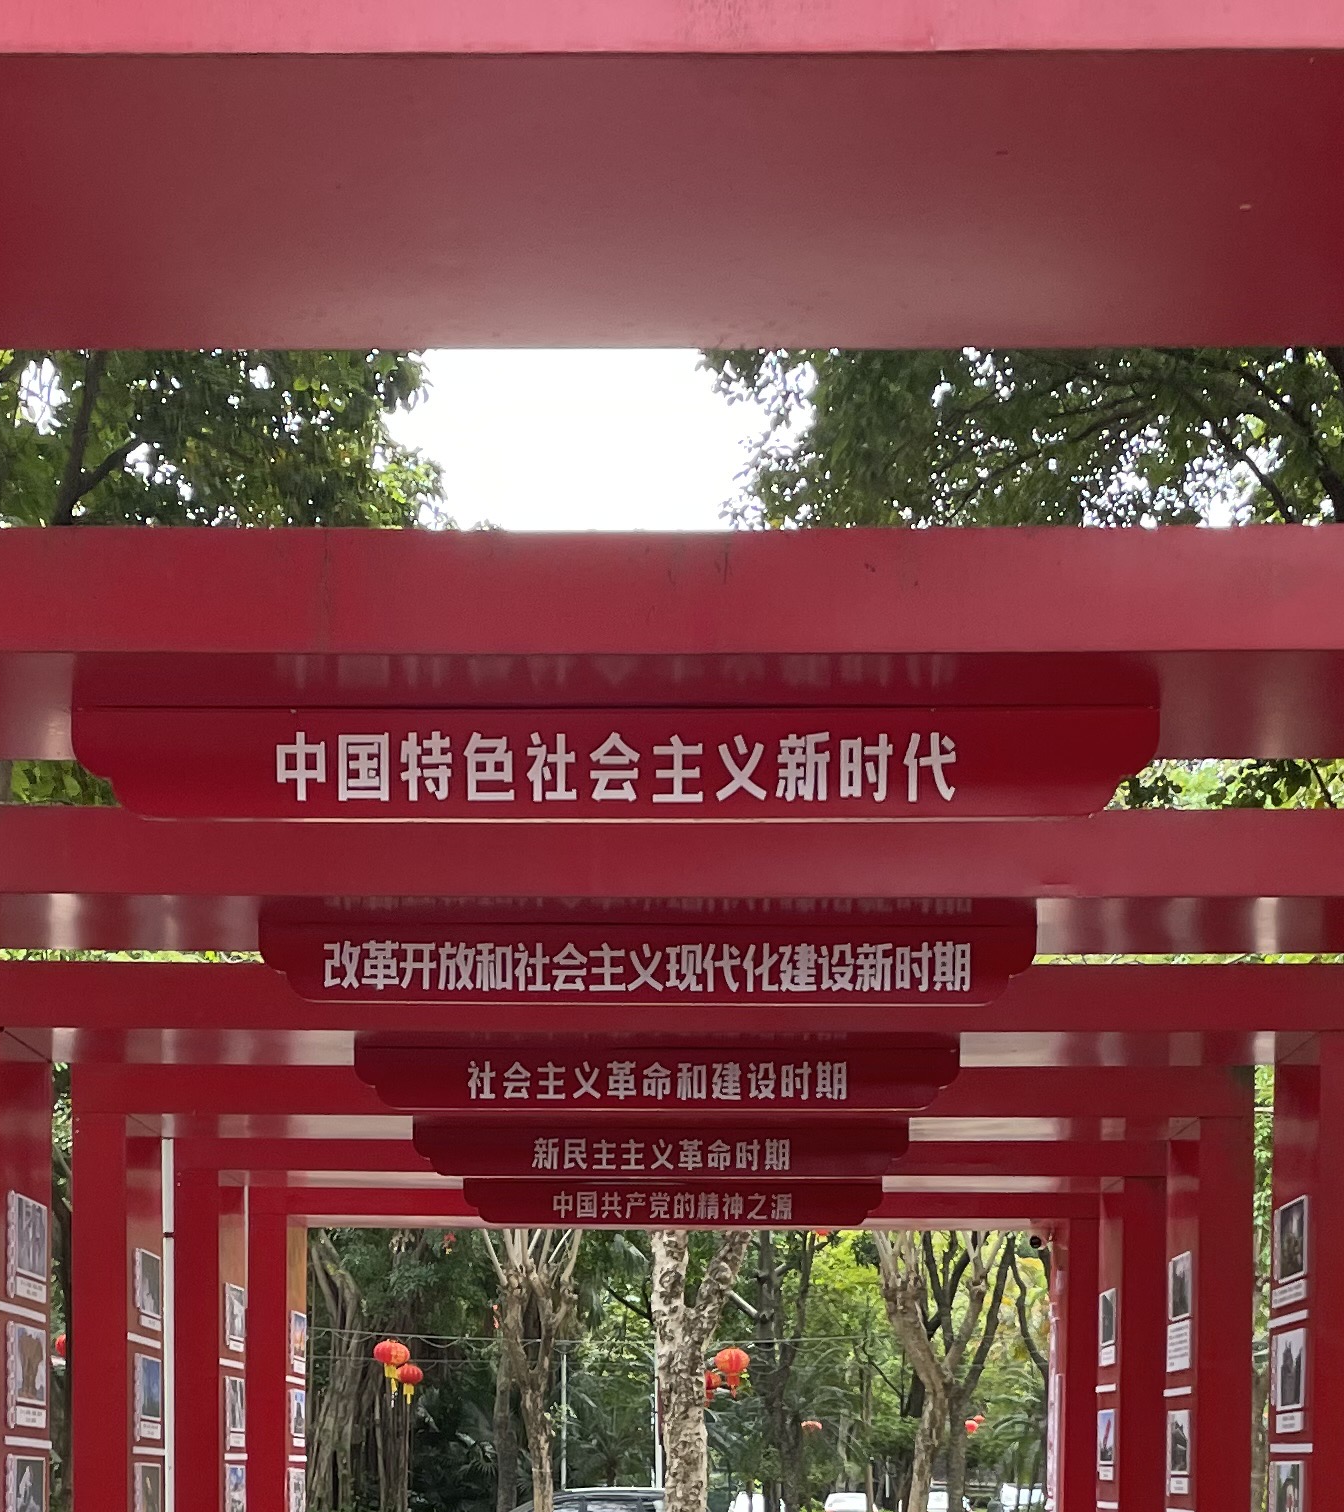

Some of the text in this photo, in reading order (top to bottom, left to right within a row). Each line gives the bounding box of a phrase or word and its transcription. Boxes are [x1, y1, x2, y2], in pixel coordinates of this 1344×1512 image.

[275, 731, 958, 804] 中国特色社会主义新时代
[323, 940, 972, 995] 改革开放和社会主义现代化建设新时期
[467, 1061, 848, 1102] 社会主义革命和建设时期
[531, 1138, 791, 1173] 新民主主义革命时期
[552, 1191, 793, 1221] 中国共产党的精神之源
